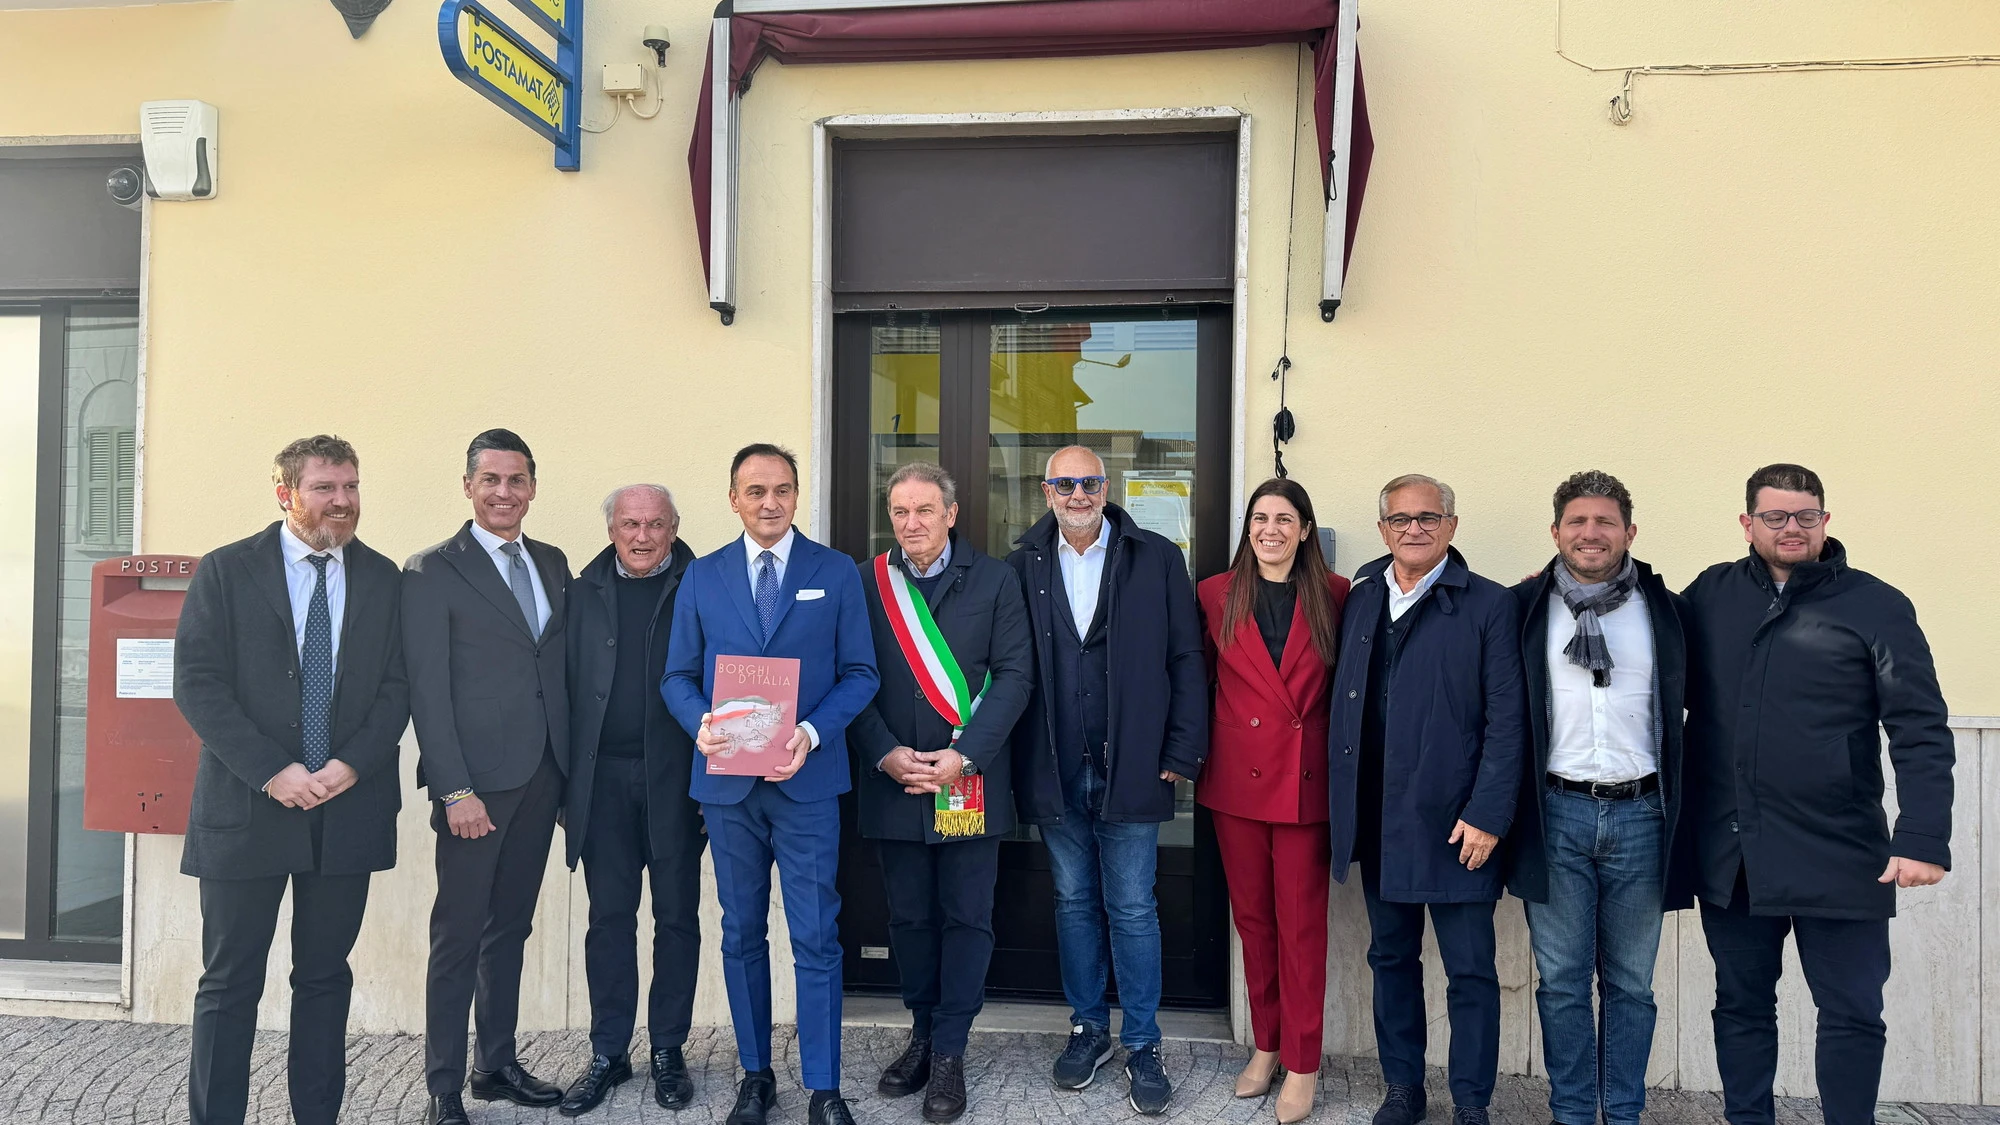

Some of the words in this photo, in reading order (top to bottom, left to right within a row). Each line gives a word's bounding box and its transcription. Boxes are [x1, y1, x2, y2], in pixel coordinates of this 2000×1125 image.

[474, 32, 543, 100] POSTAMAT
[891, 414, 902, 432] 1
[121, 559, 191, 574] POSTE
[718, 663, 770, 676] BORGHI
[738, 673, 791, 686] D'ITALIA
